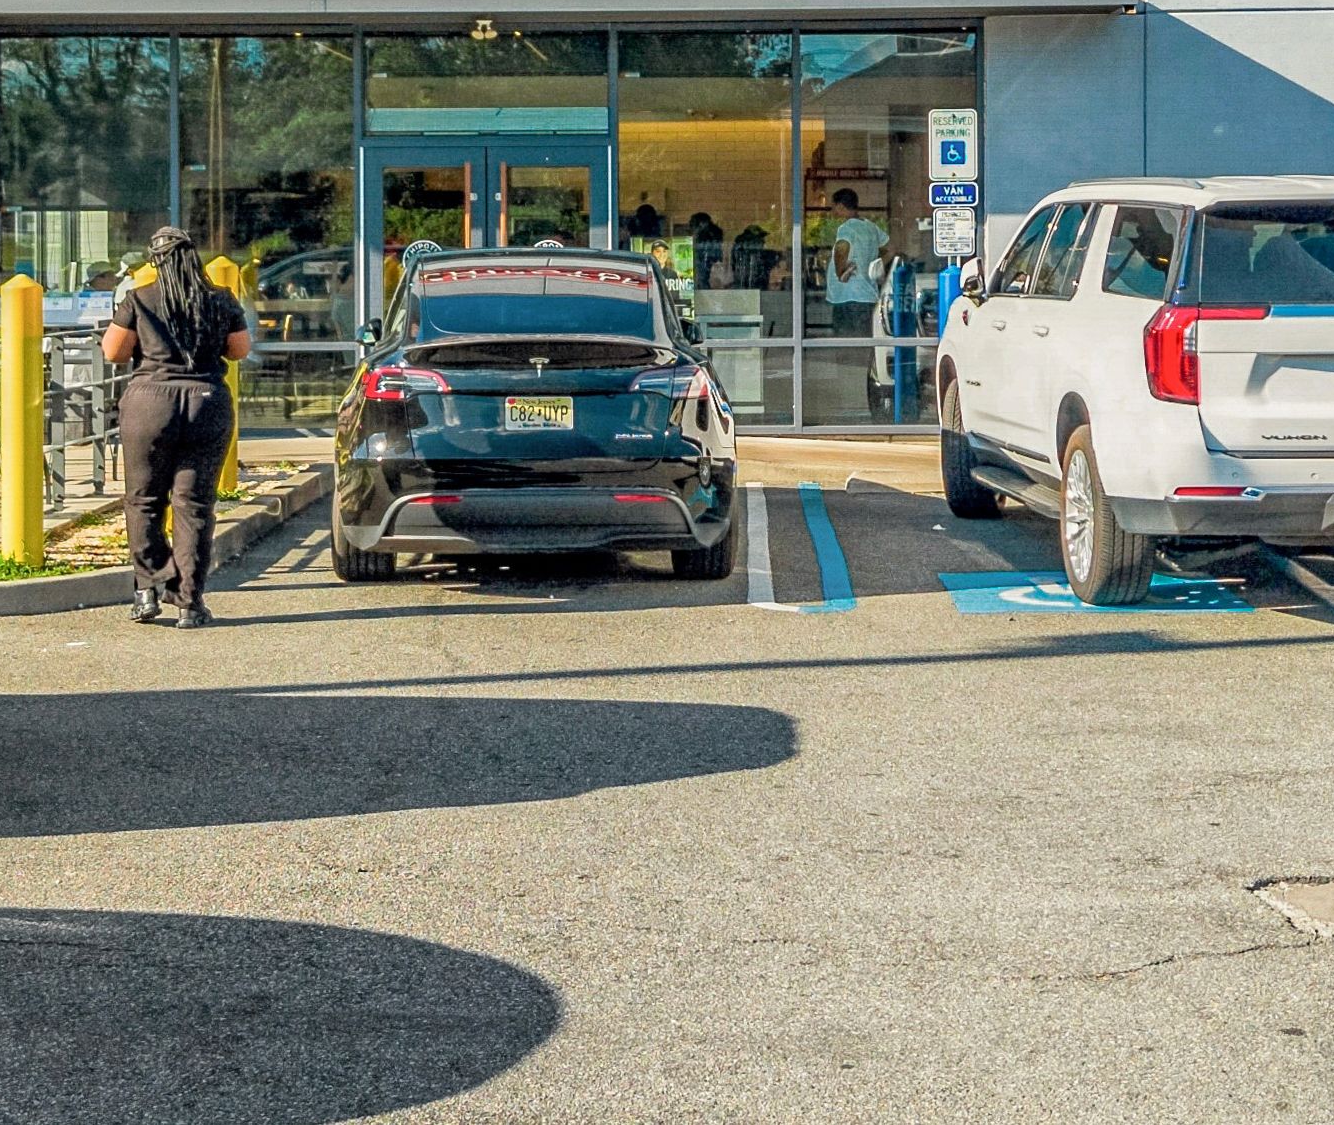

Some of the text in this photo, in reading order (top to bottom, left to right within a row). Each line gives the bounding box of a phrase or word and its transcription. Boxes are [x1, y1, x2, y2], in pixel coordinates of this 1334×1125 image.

[932, 116, 973, 126] RESERVED
[935, 128, 971, 138] PARKING
[943, 186, 964, 195] VAN
[935, 195, 973, 203] ACCESSIBLE
